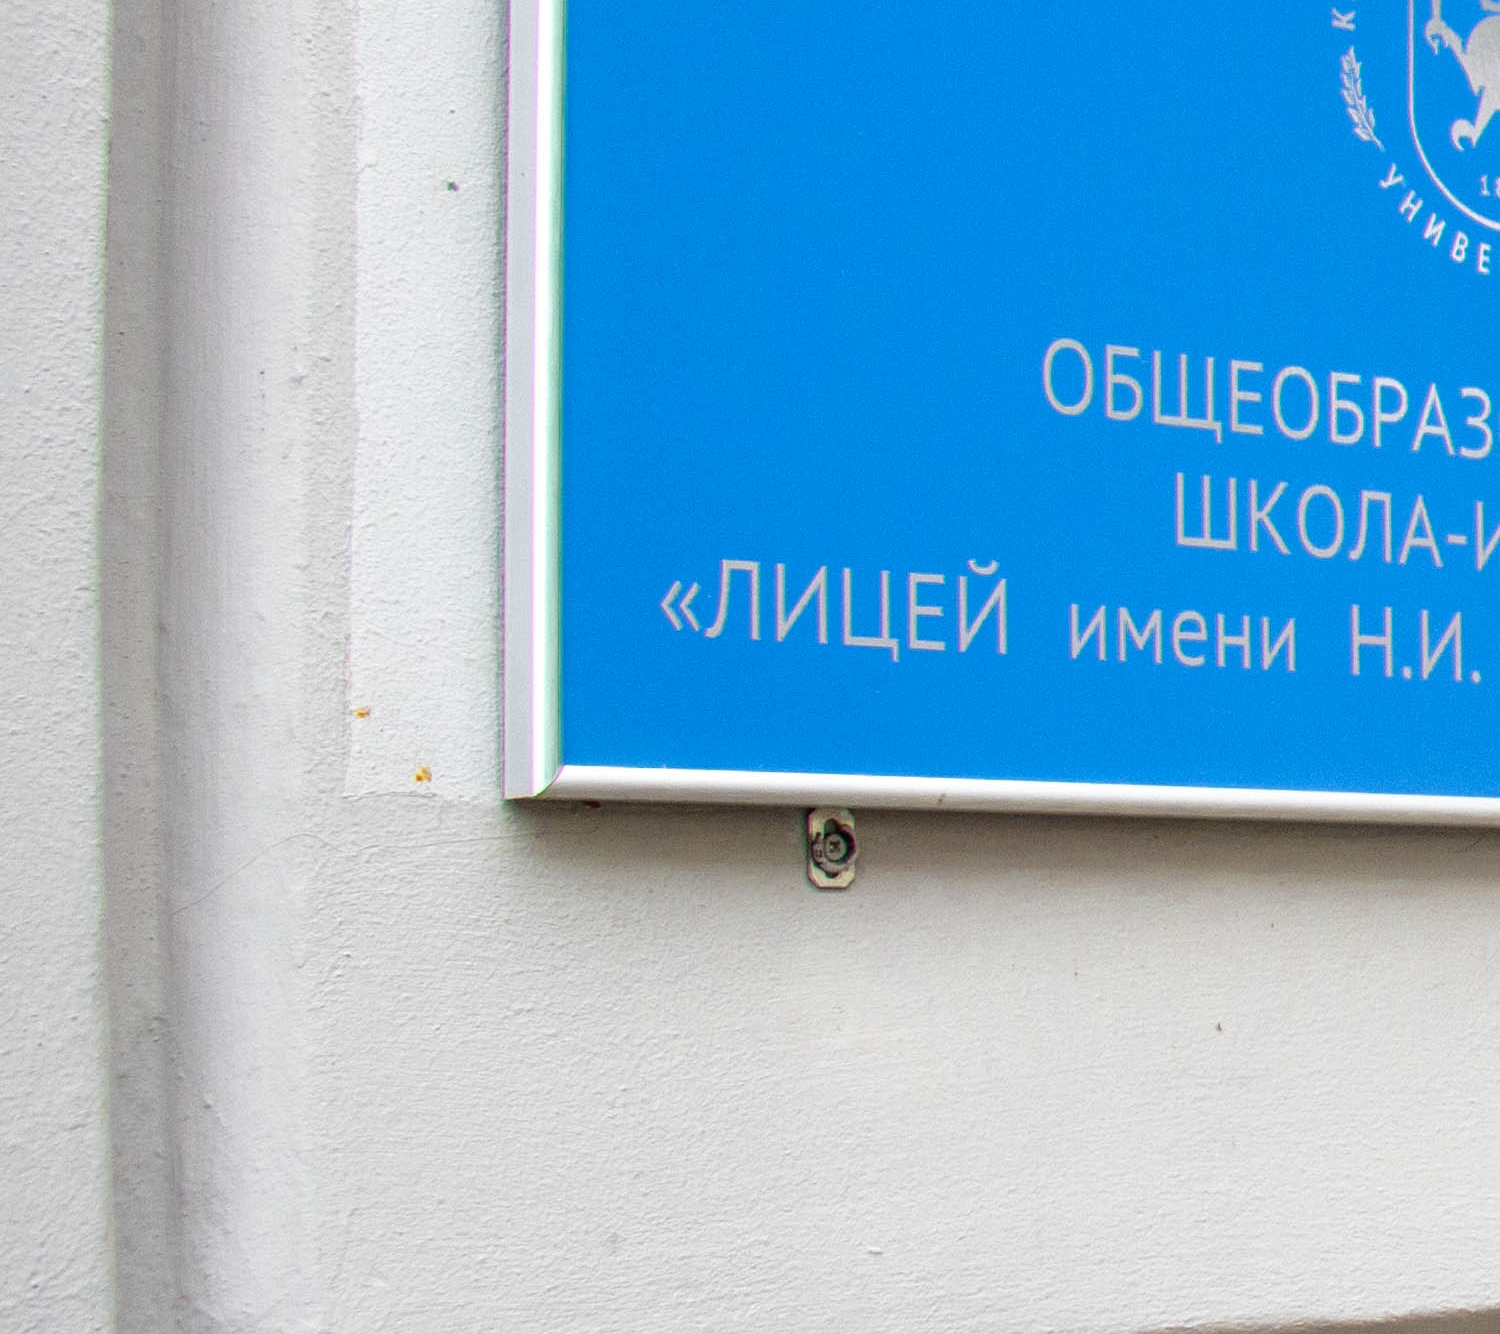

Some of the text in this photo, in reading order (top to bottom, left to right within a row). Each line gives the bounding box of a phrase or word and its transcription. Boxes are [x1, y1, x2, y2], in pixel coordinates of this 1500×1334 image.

[659, 558, 1007, 663] «ЛИЦЕЙ
[1069, 603, 1296, 673] имени
[1349, 604, 1481, 685] Н.И.
